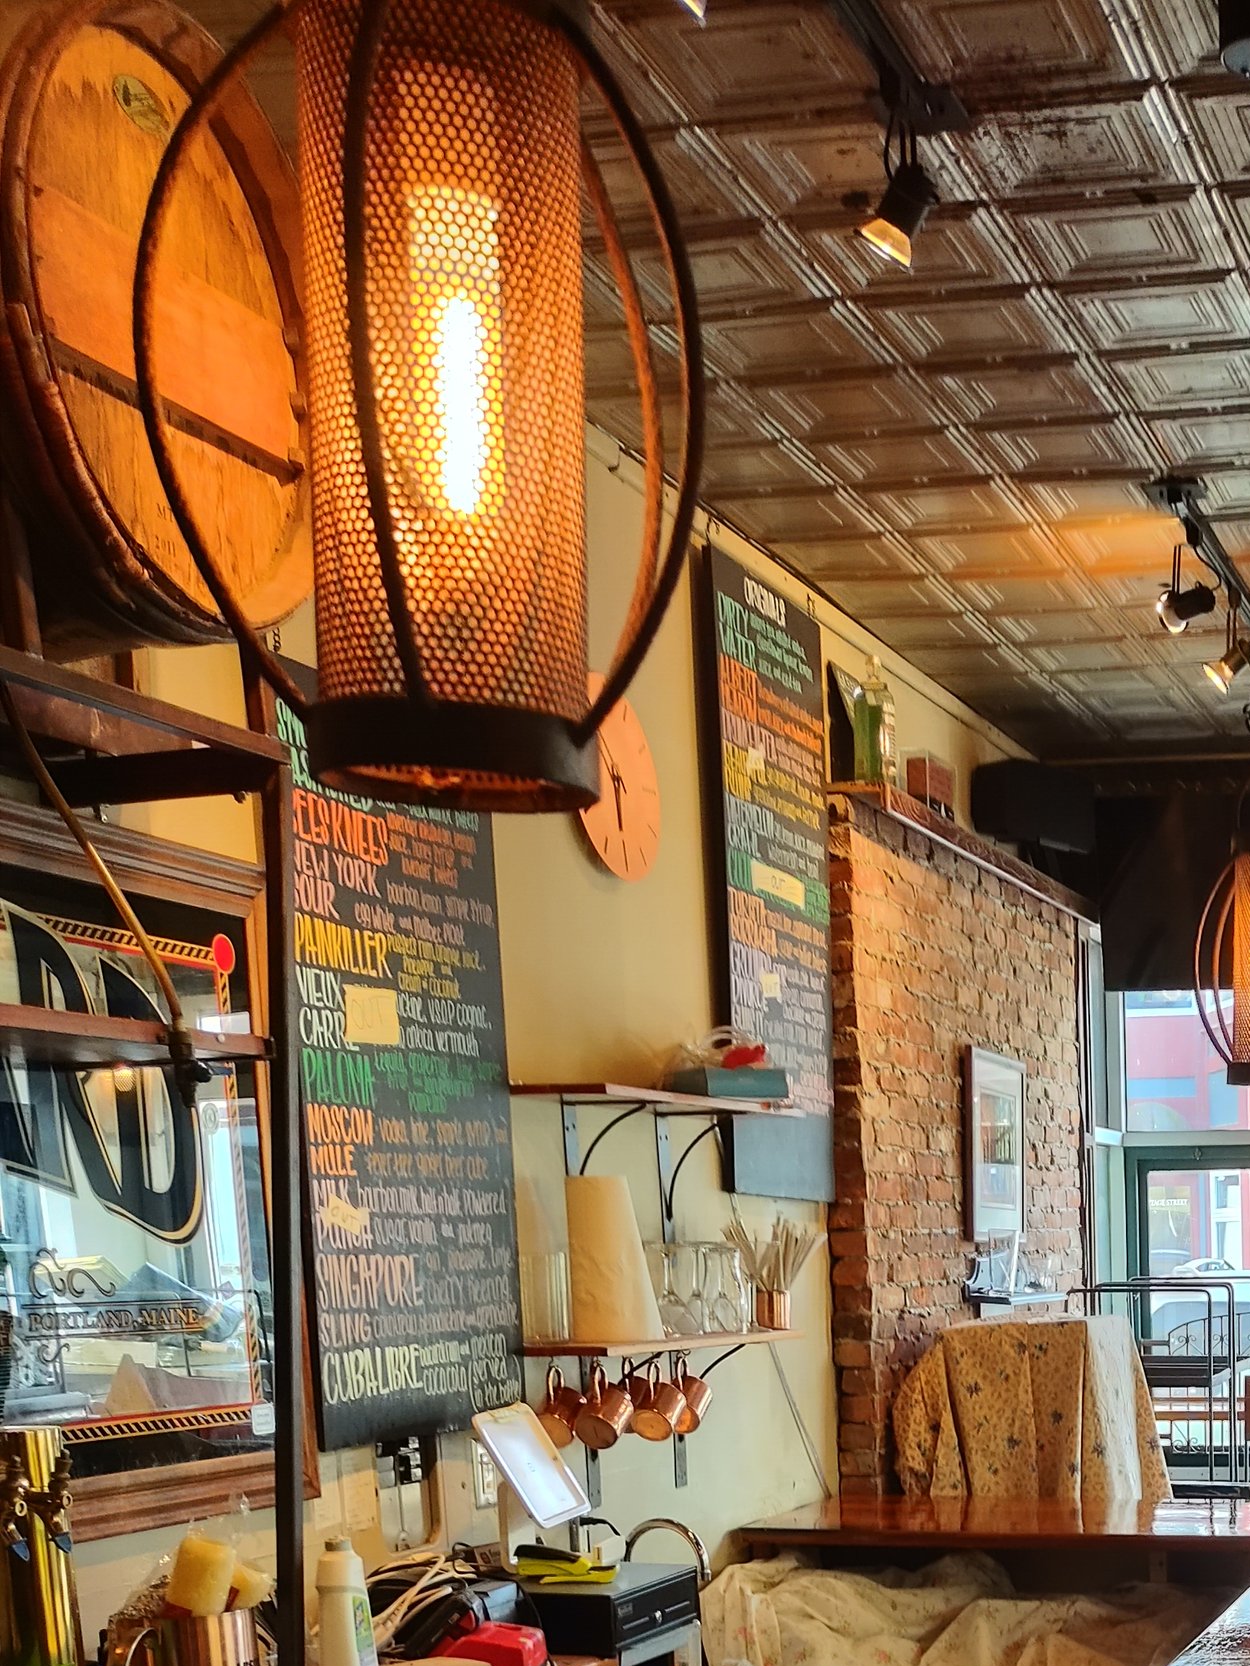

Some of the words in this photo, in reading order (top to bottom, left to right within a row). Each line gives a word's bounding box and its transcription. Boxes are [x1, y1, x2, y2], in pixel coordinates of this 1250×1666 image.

[717, 591, 748, 638] DIRTY
[718, 621, 757, 672] WATER
[330, 799, 389, 866] KNEES
[331, 851, 381, 899] YORK
[294, 911, 393, 979] PAINKILLER
[295, 964, 346, 1012] VIEUX
[299, 1006, 360, 1051] CARR
[435, 1030, 480, 1058] vermouth
[302, 1047, 376, 1109] PALOMA
[306, 1102, 374, 1147] MOSCOW
[309, 1144, 358, 1178] MULE
[315, 1252, 425, 1310] SINGAPORE
[28, 1308, 141, 1332] PORTLAND,
[141, 1306, 200, 1329] MAINE
[319, 1312, 372, 1348] SLING
[323, 1347, 378, 1405] CUBA
[376, 1343, 424, 1396] LIBRE
[484, 1381, 498, 1407] the
